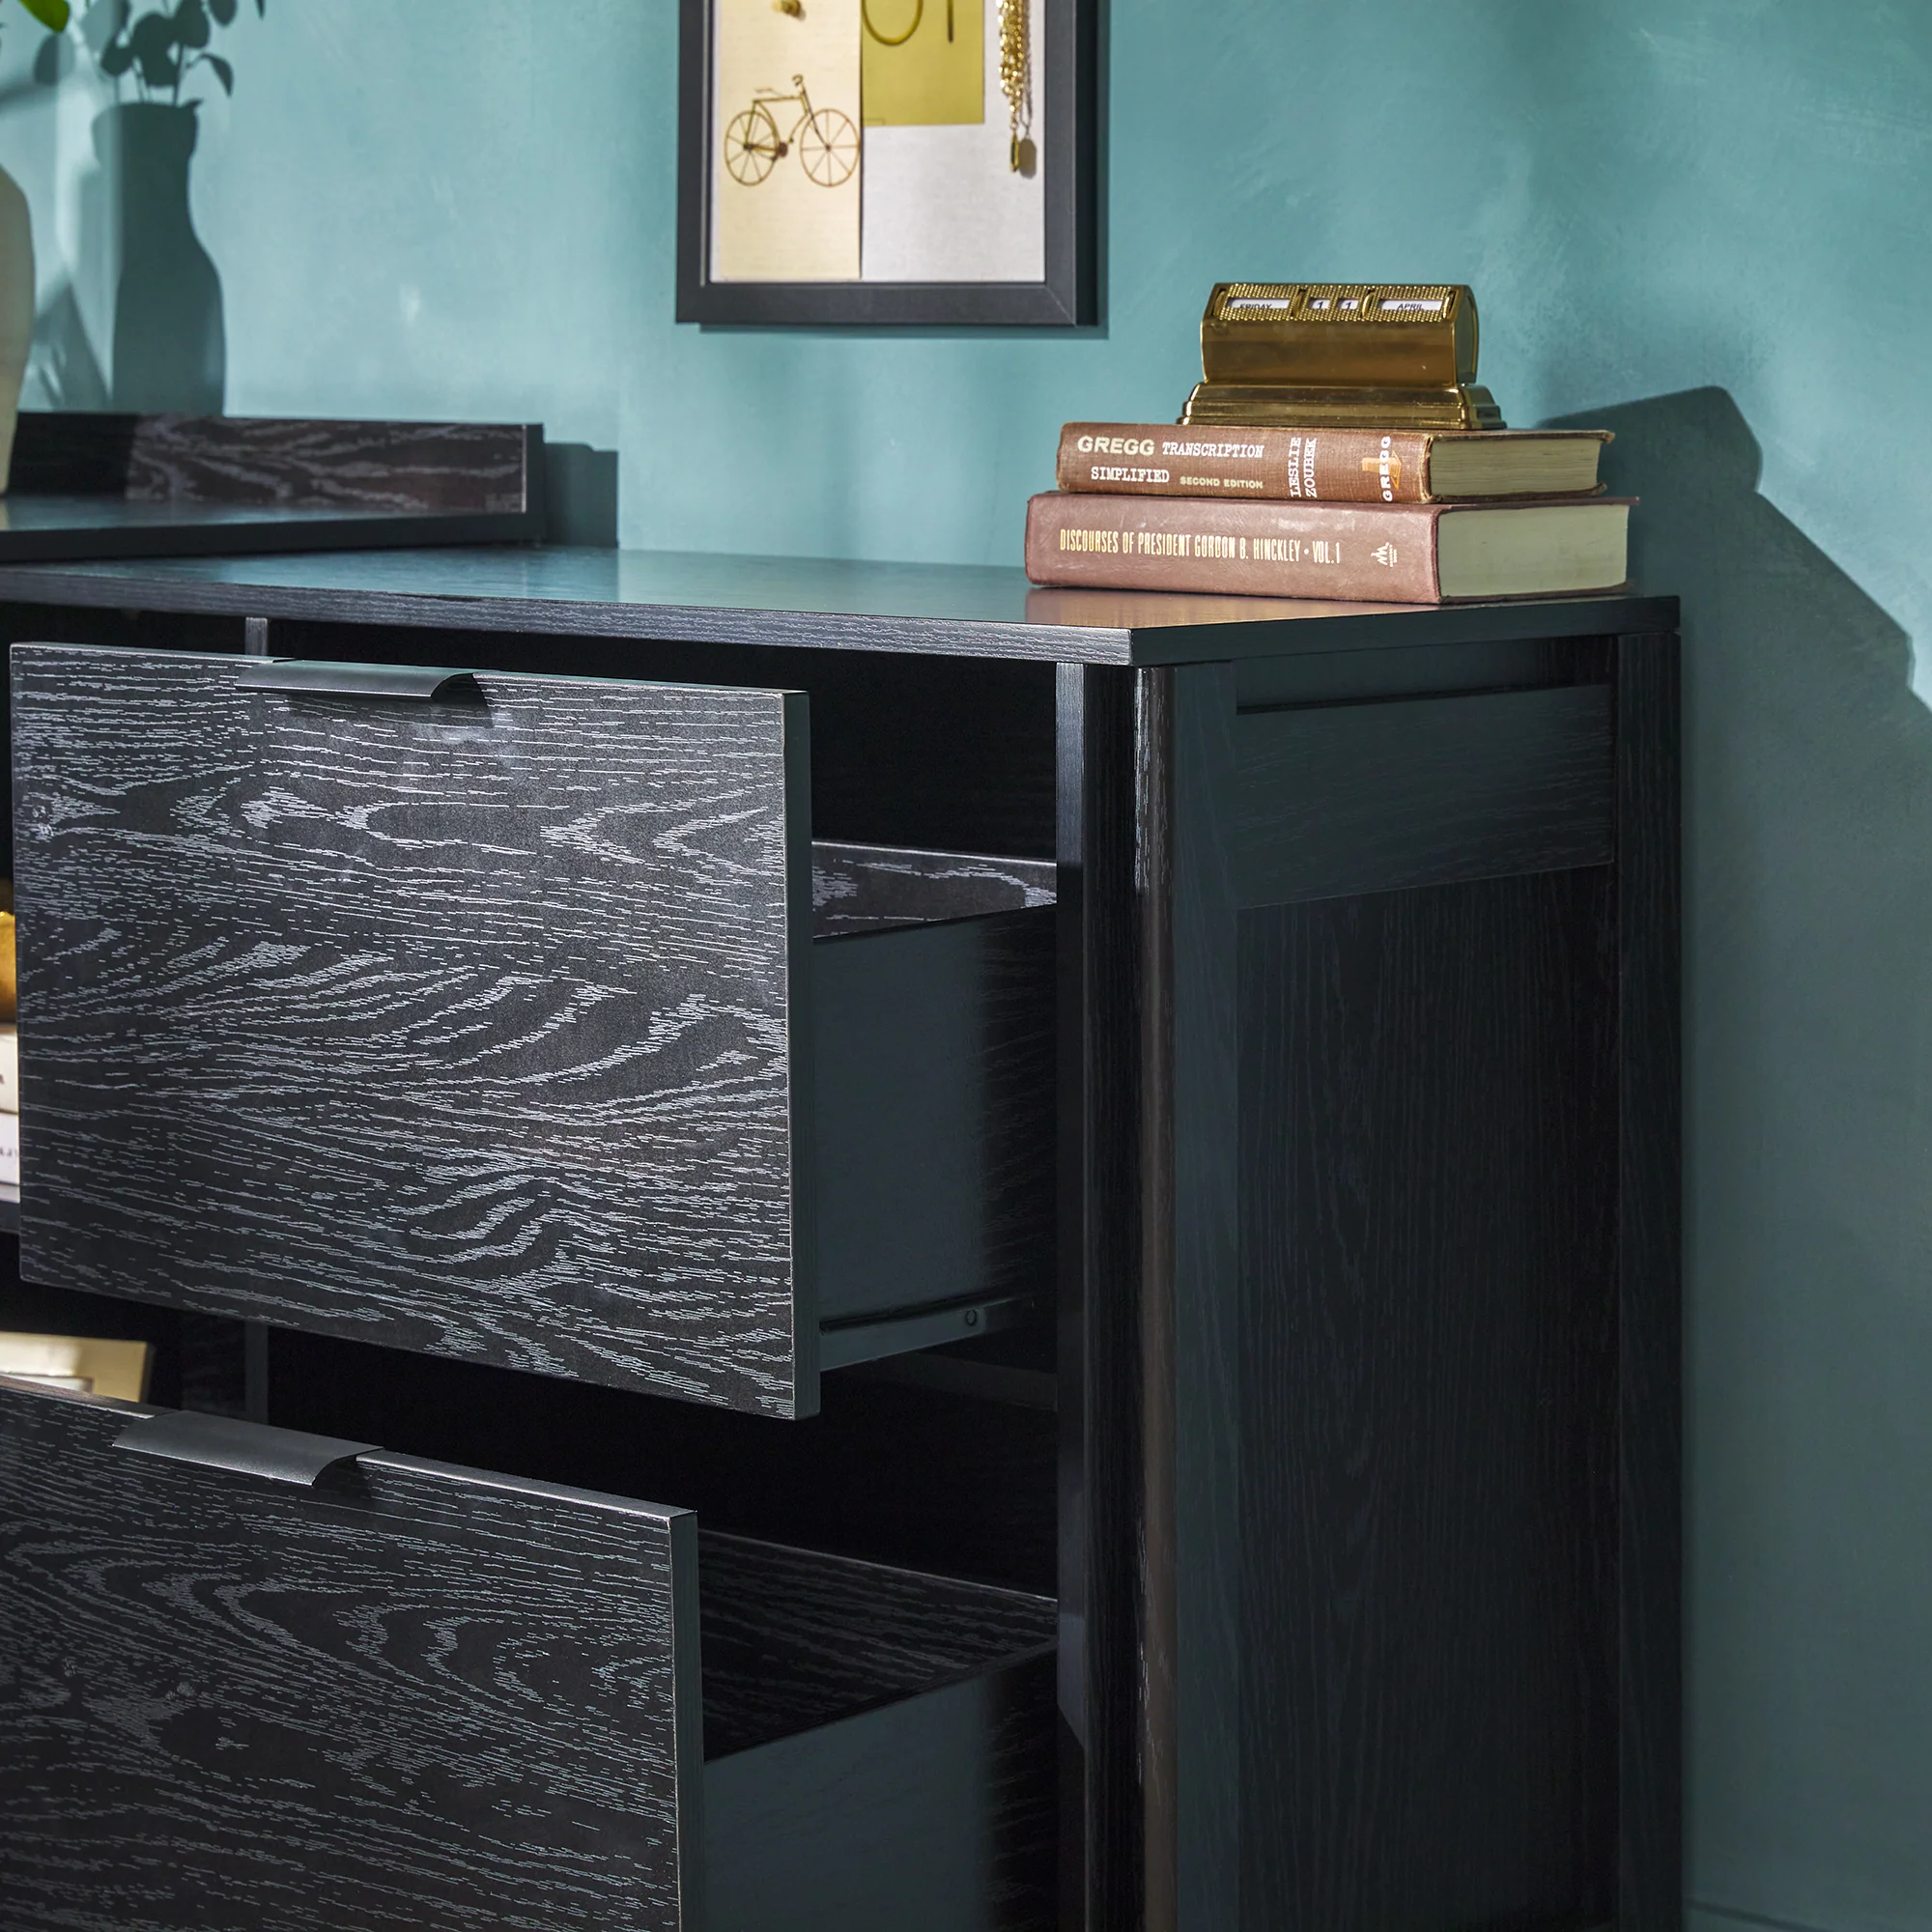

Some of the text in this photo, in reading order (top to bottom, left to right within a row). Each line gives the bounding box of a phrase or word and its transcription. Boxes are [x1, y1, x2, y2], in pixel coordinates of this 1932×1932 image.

[1077, 435, 1264, 459] GREGG TRANSCRIPTION
[1091, 466, 1170, 483] SIMPLIFIED
[1179, 475, 1264, 489] SECOND EDITION
[1288, 437, 1301, 497] LESLIE
[1304, 438, 1317, 498] ZOUBEK
[1379, 436, 1393, 501] GREGG
[1060, 528, 1119, 554] DISCOURSES
[1122, 531, 1134, 554] OF
[1137, 532, 1191, 556] PRESIDENT
[1194, 534, 1236, 558] GORDON
[1239, 537, 1249, 559] B.
[1253, 538, 1300, 562] HINCKLEY
